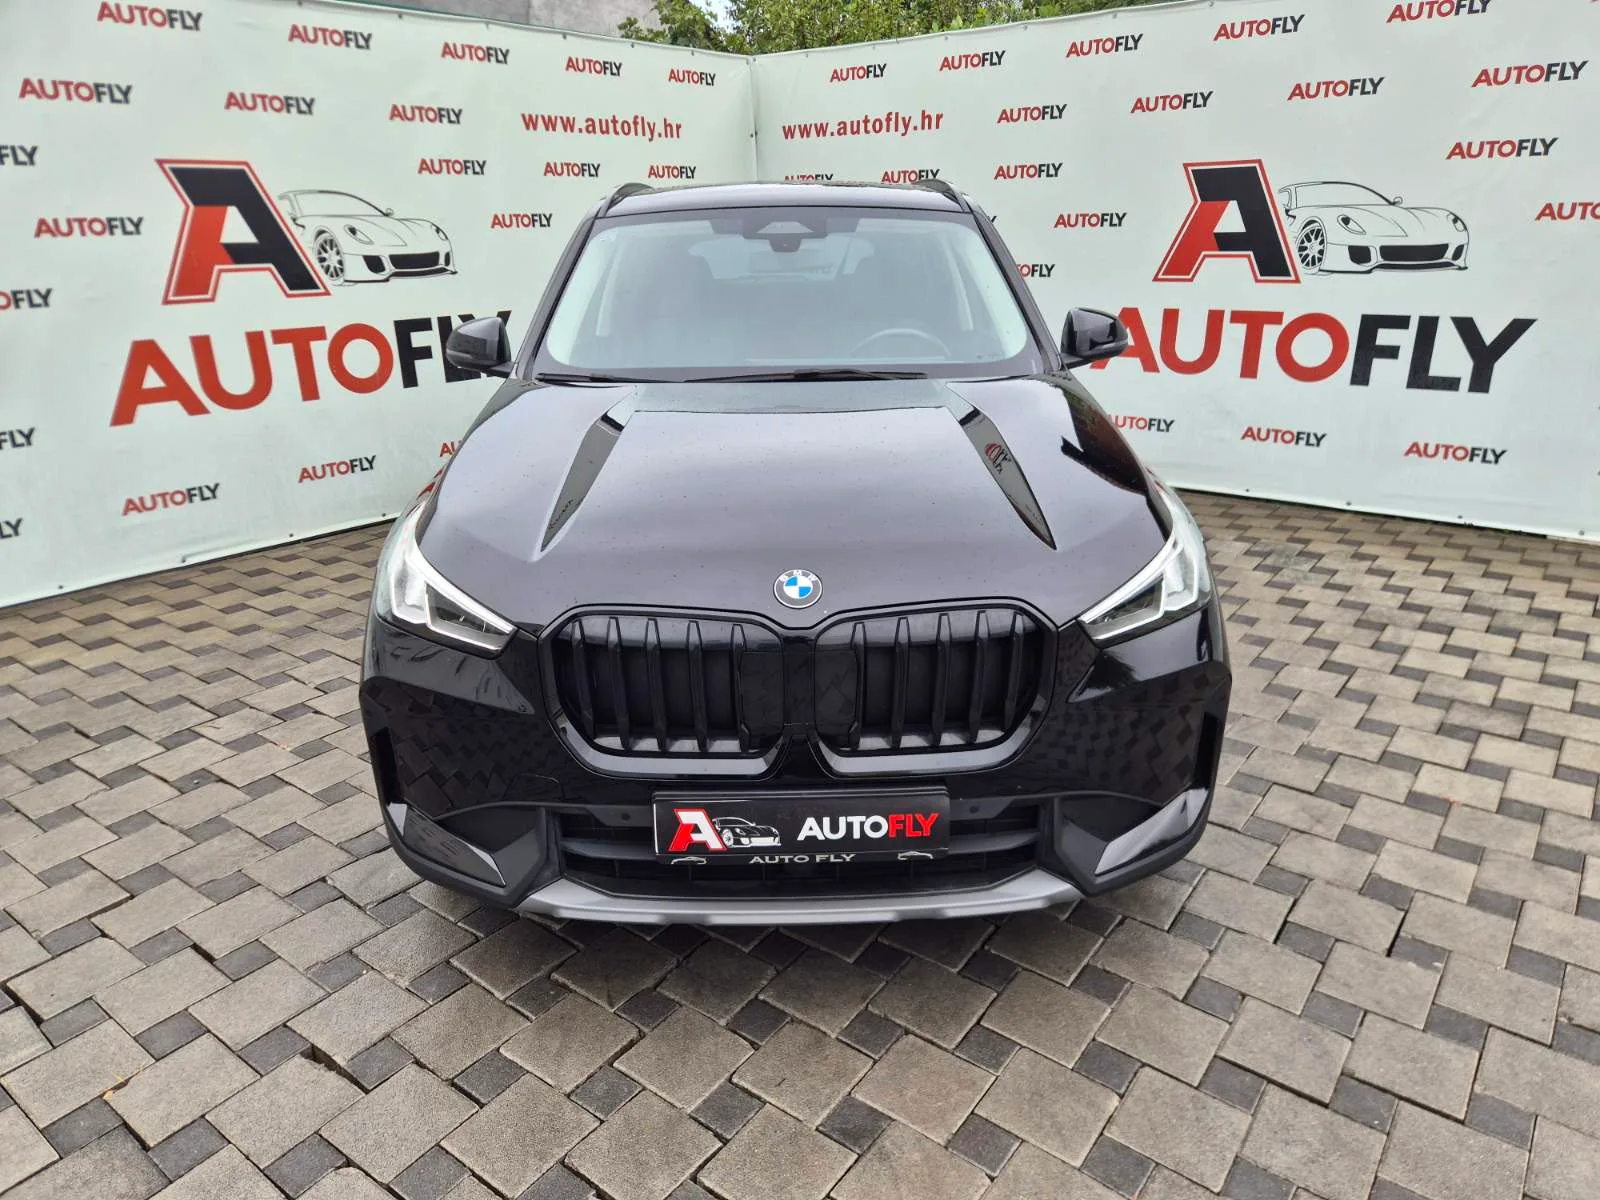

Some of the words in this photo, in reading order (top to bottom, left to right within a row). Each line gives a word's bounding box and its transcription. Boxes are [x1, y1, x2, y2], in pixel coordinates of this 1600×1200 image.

[97, 2, 202, 31] AUTOFLY
[1387, 0, 1491, 23] AUTOFLY
[288, 24, 372, 50] AUTOFLY
[1214, 14, 1305, 41] AUTOFLY
[441, 42, 509, 64] AUTOFLY
[1066, 34, 1143, 58] AUTOFLY
[566, 56, 622, 76] AUTOFLY
[940, 50, 1005, 71] AUTOFLY
[668, 69, 716, 86] AUTOFLY
[830, 63, 886, 82] AUTOFLY
[1472, 61, 1588, 87] AUTOFLY
[19, 78, 132, 104] AUTOFLY
[1288, 77, 1384, 100] AUTOFLY
[225, 92, 315, 115] AUTOFLY
[1131, 91, 1213, 113] AUTOFLY
[390, 104, 462, 124] AUTOFLY
[782, 110, 943, 139] www.autofly.hr
[997, 104, 1067, 123] AUTOFLY
[521, 113, 682, 142] www.autofly.hr
[1446, 138, 1558, 160] AUTOFLY
[418, 159, 486, 175] AUTOFLY
[544, 162, 600, 177] AUTOFLY
[648, 165, 696, 179] AUTOFLY
[994, 163, 1063, 180] AUTOFLY
[35, 217, 143, 238] AUTOFLY
[491, 213, 552, 228] AUTOFLY
[1054, 213, 1127, 228] AUTOFLY
[1090, 307, 1538, 394] AUTOFLY
[1108, 415, 1174, 432] UTOFLY
[1241, 427, 1327, 447] AUTOFLY
[1404, 442, 1507, 464] AUTOFLY
[299, 455, 376, 483] AUTOFLY
[123, 483, 219, 516] AUTOFLY
[797, 812, 940, 841] AUTOFLY
[749, 854, 810, 864] AUTO
[815, 853, 857, 863] FLY
